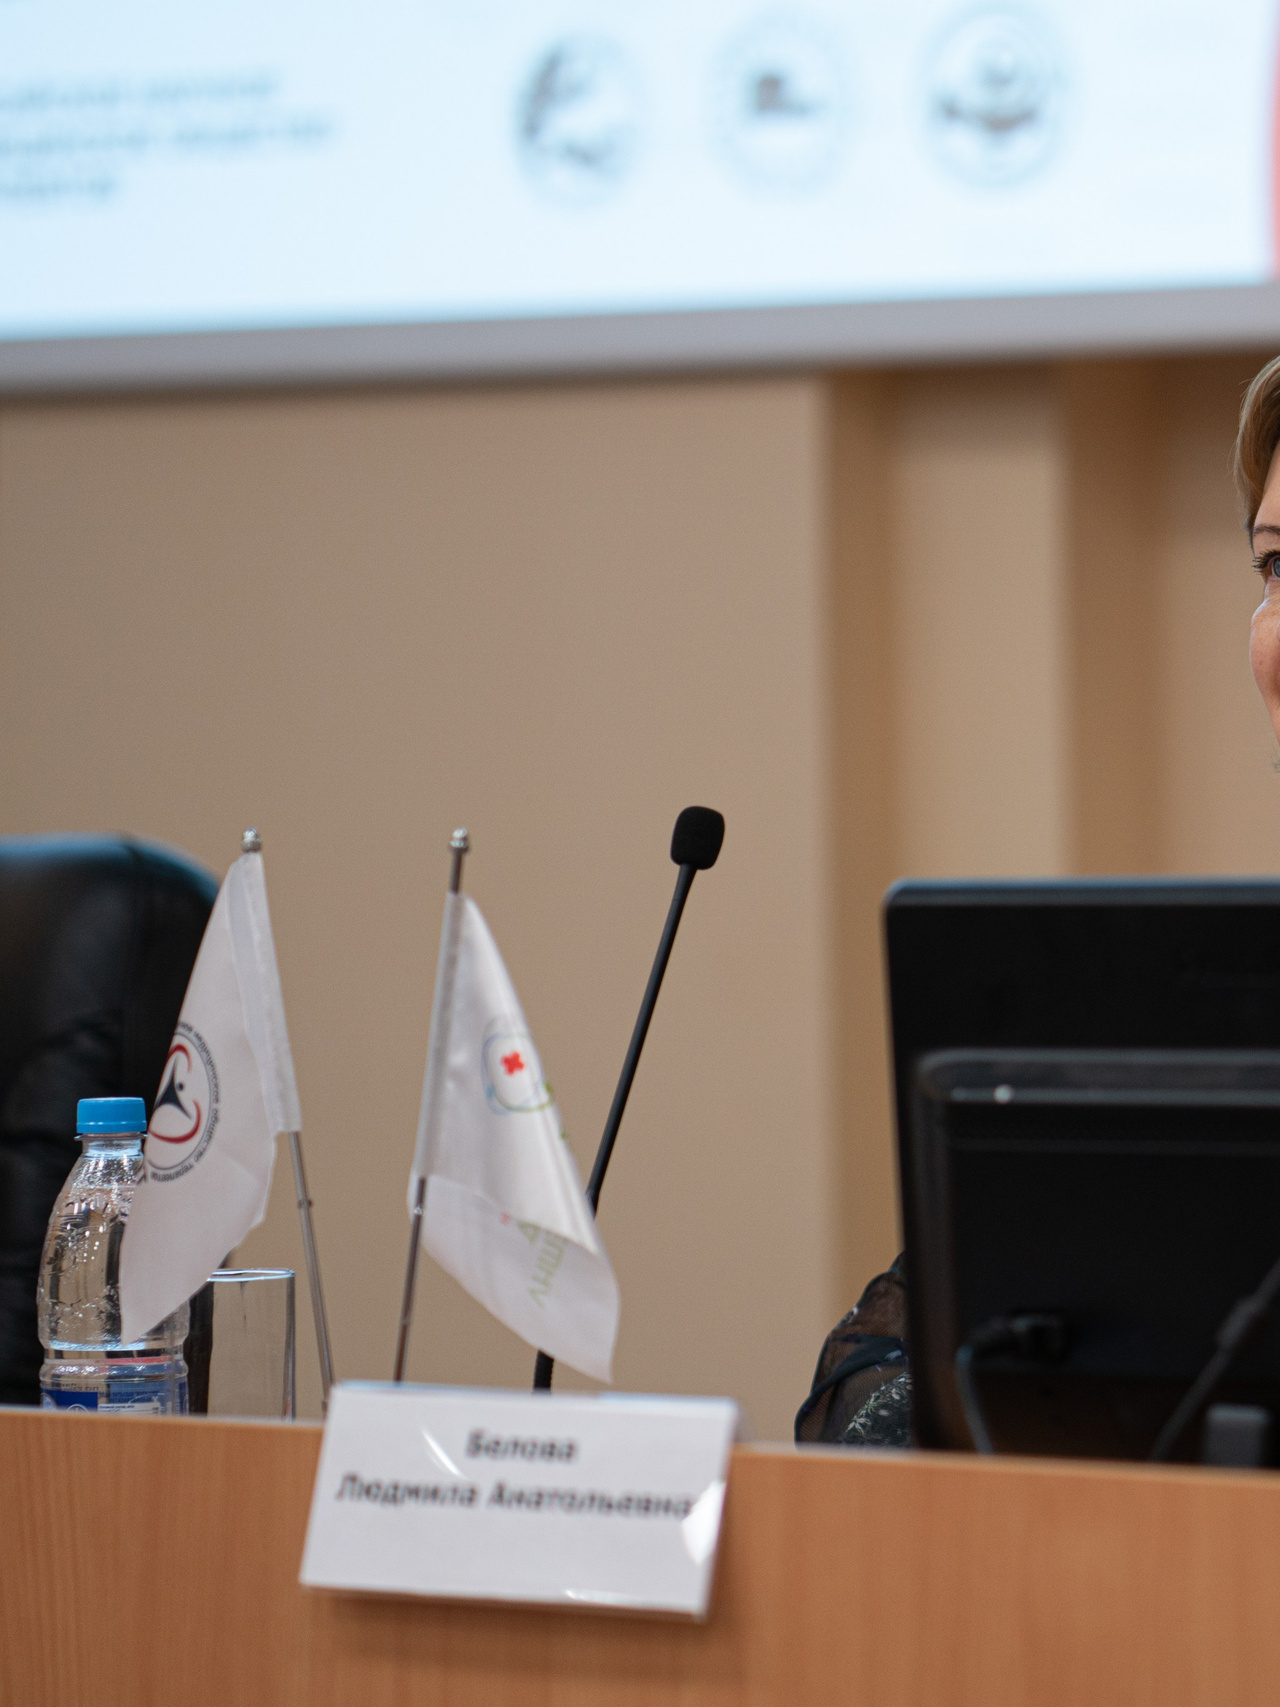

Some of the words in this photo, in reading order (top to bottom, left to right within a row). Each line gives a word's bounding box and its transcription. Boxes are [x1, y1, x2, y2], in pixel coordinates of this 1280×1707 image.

[466, 1429, 576, 1463] Белова
[335, 1471, 477, 1508] Людмила
[486, 1481, 694, 1518] Анатольевна
